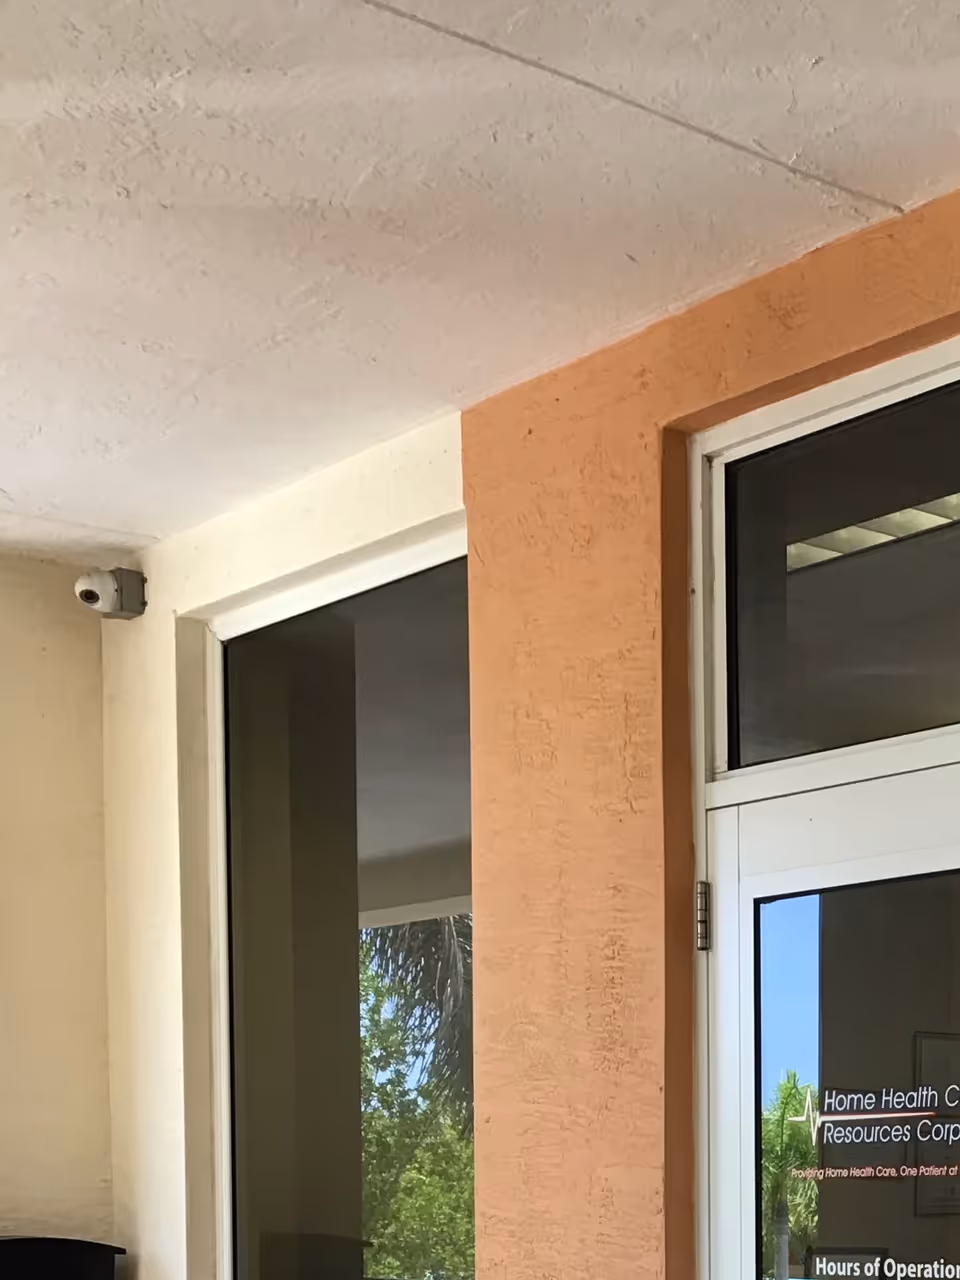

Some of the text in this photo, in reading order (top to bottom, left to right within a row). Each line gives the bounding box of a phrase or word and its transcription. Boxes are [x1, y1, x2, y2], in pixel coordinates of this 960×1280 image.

[824, 1089, 876, 1112] Home
[881, 1086, 938, 1109] Health
[823, 1122, 911, 1144] Resources
[825, 1167, 848, 1178] Home
[850, 1166, 874, 1177] Health
[900, 1165, 917, 1177] One
[919, 1164, 947, 1176] Patient
[948, 1165, 958, 1176] at
[815, 1257, 860, 1277] Hours
[864, 1257, 881, 1277] of
